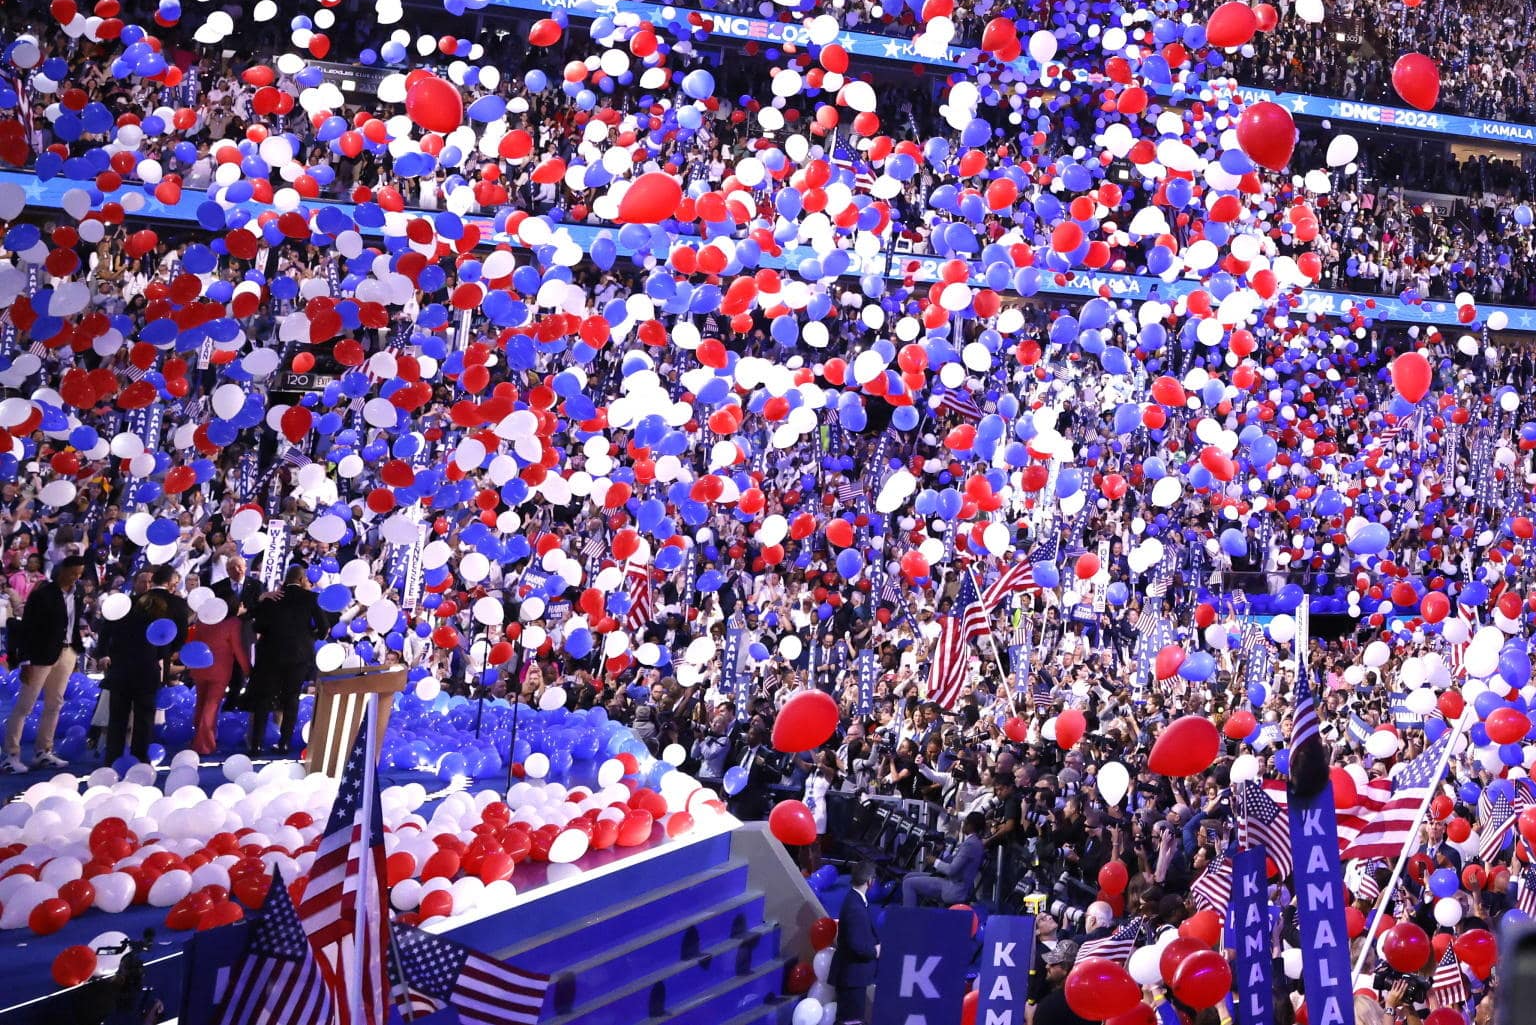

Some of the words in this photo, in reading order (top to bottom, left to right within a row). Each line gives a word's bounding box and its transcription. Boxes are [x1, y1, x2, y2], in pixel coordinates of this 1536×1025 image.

[322, 68, 354, 77] LEXUS
[1340, 102, 1381, 122] DNC
[1394, 109, 1440, 129] 2024
[1482, 123, 1534, 141] KAMALA
[286, 374, 309, 385] 120
[147, 408, 161, 450] KAMALA
[871, 436, 887, 473] KAMALA
[1069, 509, 1088, 548] KAMALA
[686, 552, 695, 600] KAMALA
[1189, 549, 1202, 588] KAMALA
[549, 604, 570, 614] HARRIS
[723, 634, 738, 688] KAMALA
[861, 655, 870, 709] KAMALA
[1302, 808, 1345, 1025] KAMALA
[1242, 870, 1265, 1025] KAMAL
